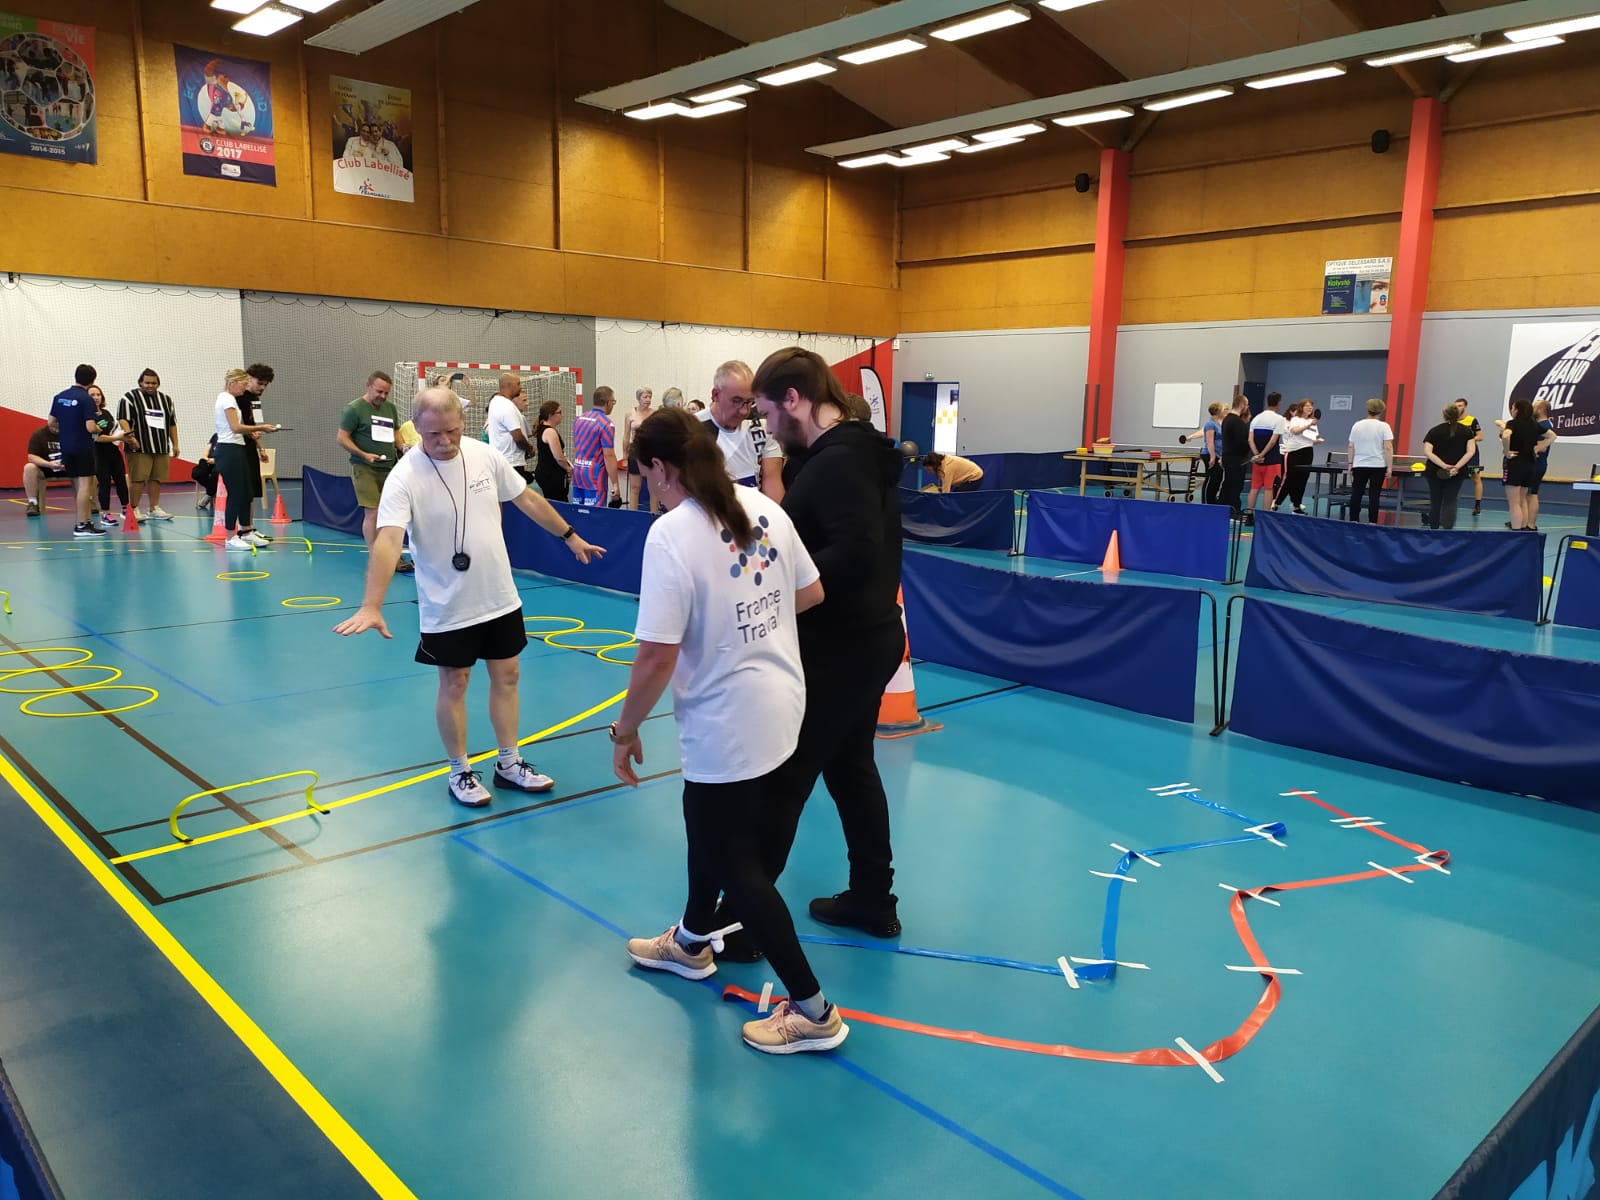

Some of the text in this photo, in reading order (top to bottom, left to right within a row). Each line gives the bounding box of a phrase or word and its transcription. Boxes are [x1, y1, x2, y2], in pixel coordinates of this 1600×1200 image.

[30, 145, 66, 155] 2014-2015
[216, 139, 233, 148] CLUB
[216, 146, 242, 159] 2017
[337, 158, 411, 181] Club Labellisé
[1541, 359, 1591, 385] HAND
[1533, 384, 1574, 411] BALL
[1556, 413, 1596, 428] Falaise
[736, 589, 781, 622] France
